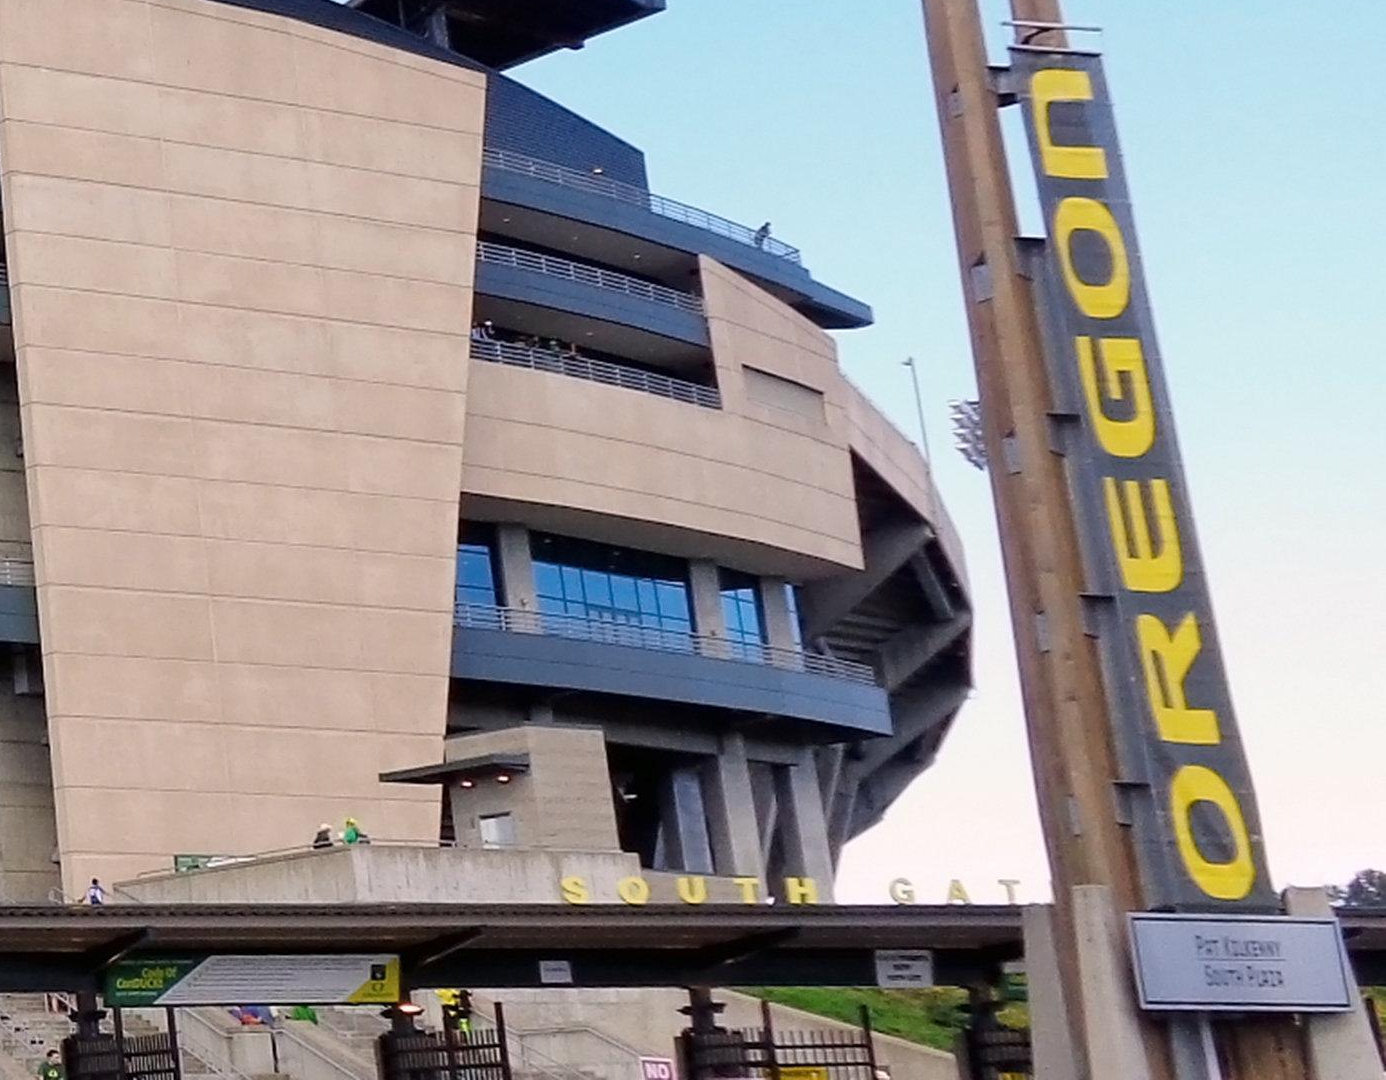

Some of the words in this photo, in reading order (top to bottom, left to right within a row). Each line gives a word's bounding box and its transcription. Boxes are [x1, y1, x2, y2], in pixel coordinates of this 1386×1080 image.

[1032, 68, 1257, 900] OREGON
[560, 876, 820, 905] SOUTH
[889, 877, 1021, 905] GAT
[644, 1063, 670, 1079] NO
